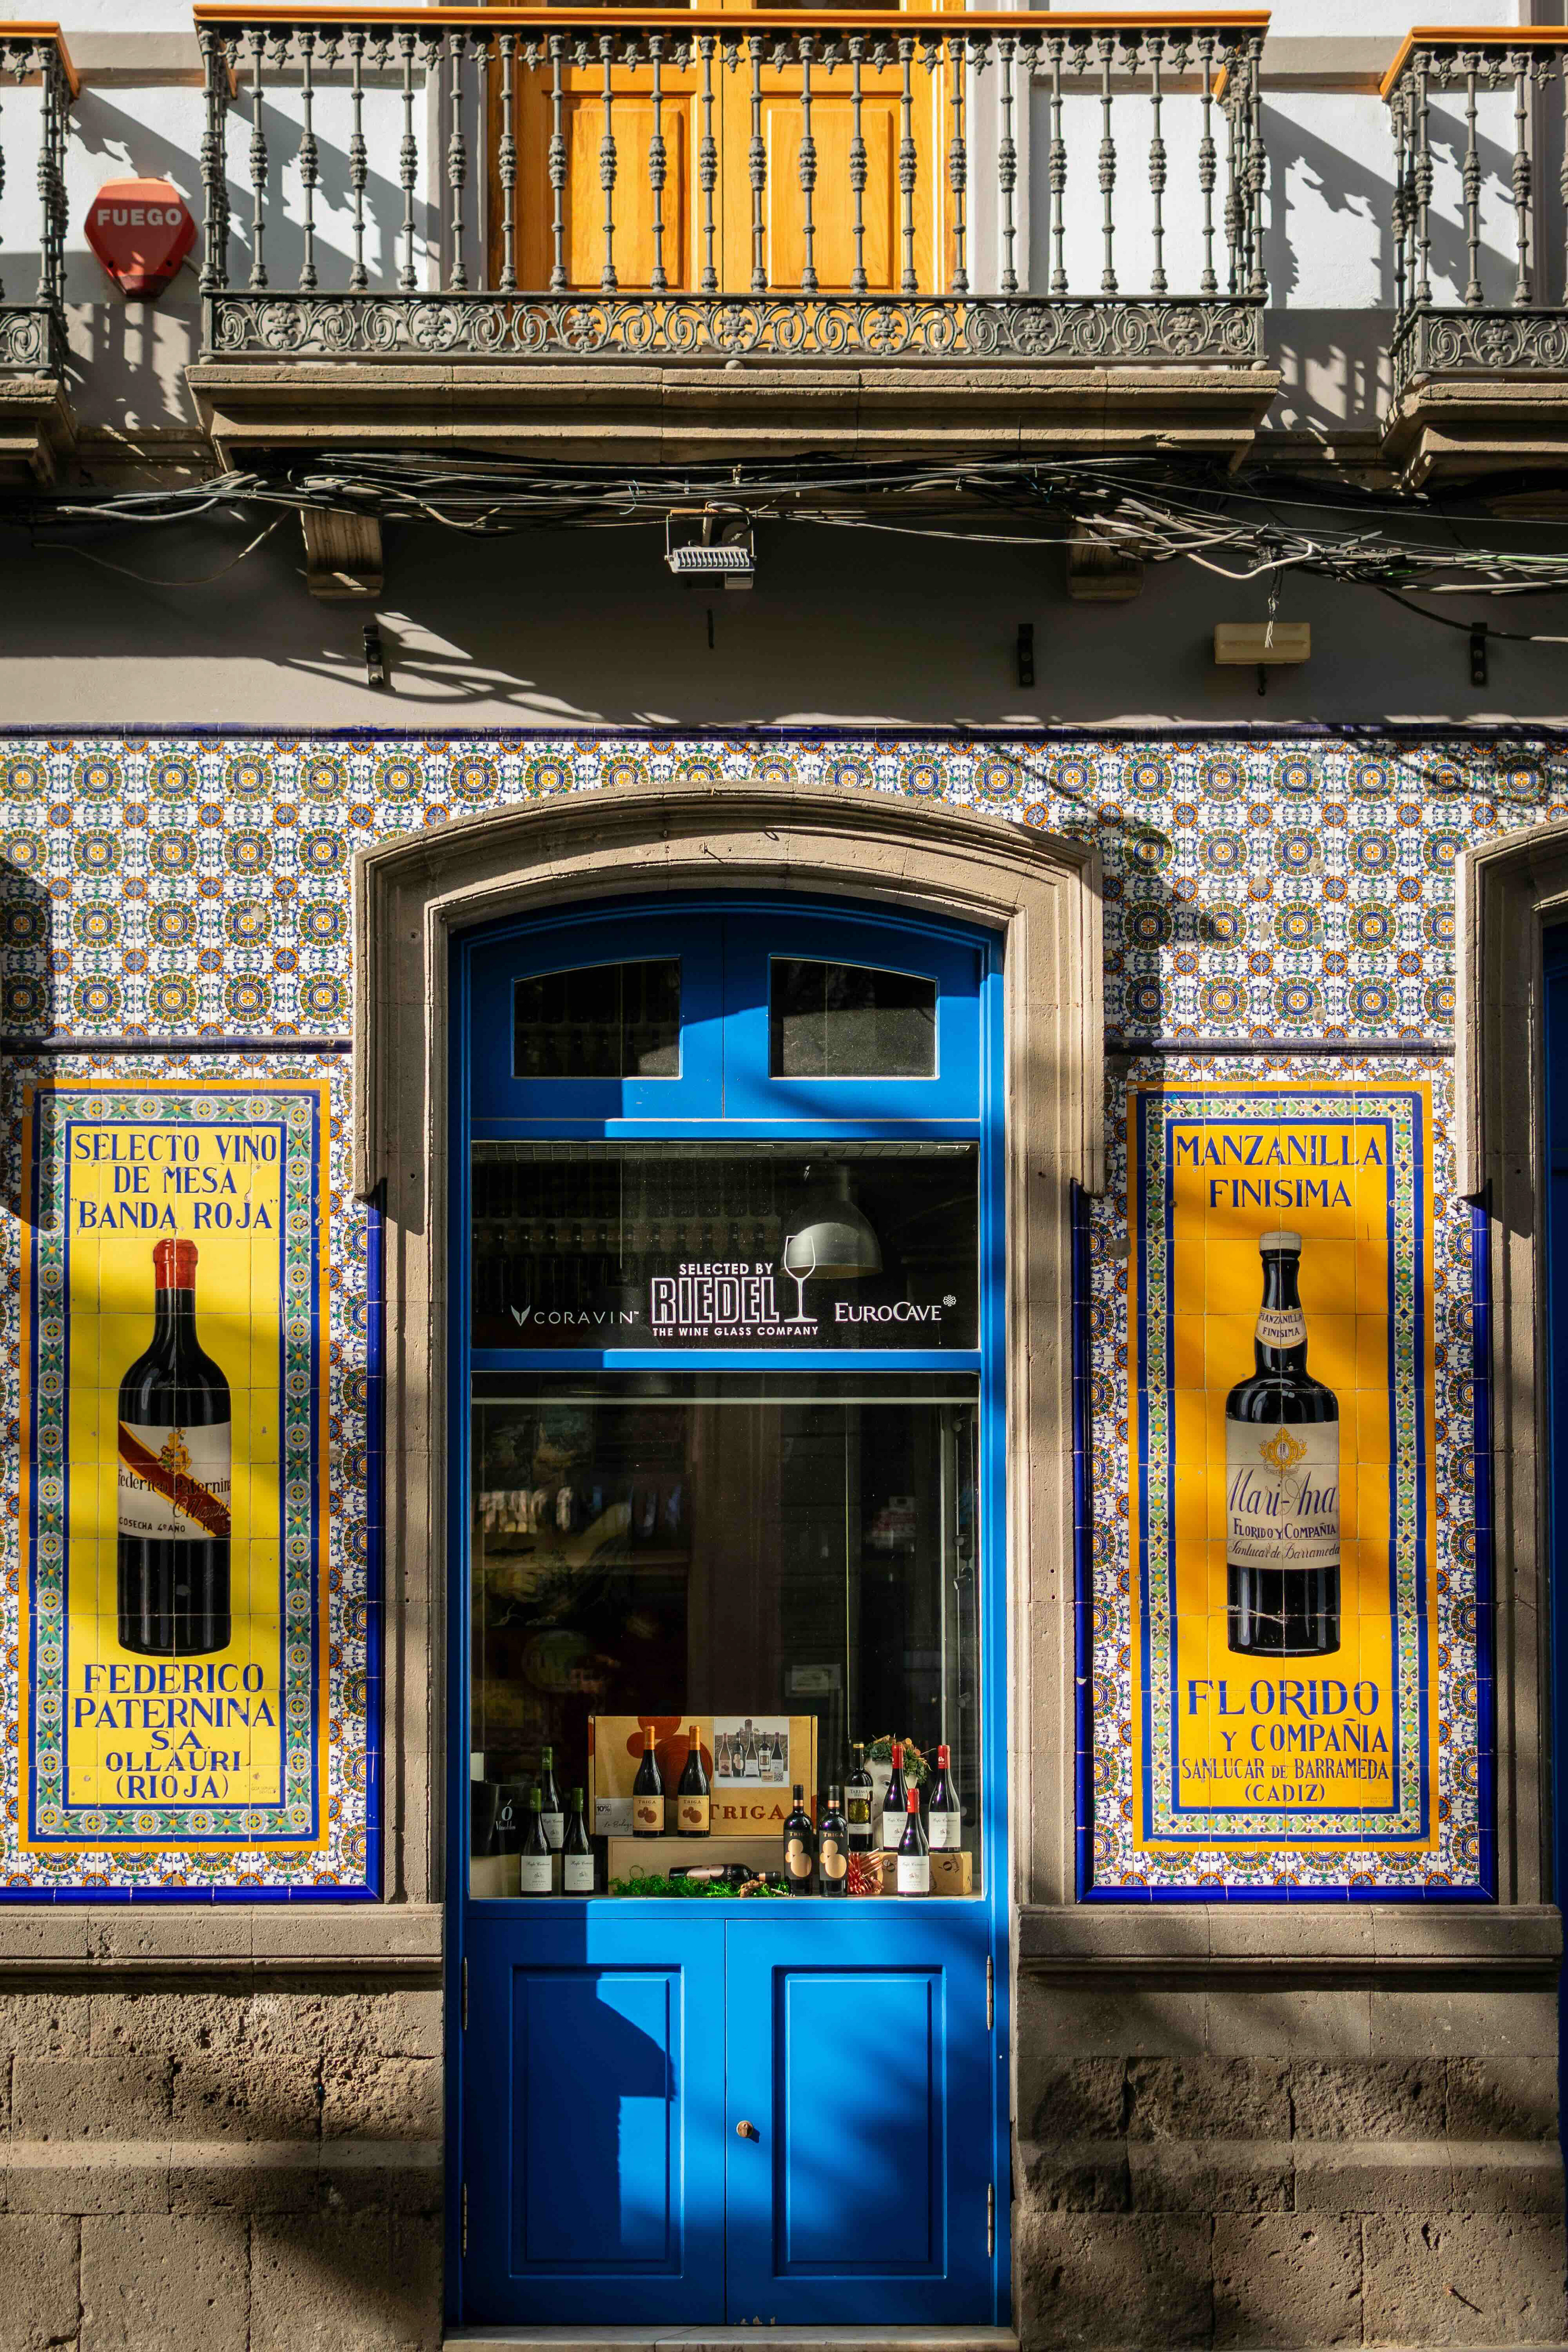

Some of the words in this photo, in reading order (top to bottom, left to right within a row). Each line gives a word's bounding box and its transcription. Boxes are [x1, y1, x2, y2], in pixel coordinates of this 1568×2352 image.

[98, 208, 182, 226] FUEGO
[75, 1134, 199, 1161] SELECTO
[215, 1135, 277, 1162] VINO
[1177, 1135, 1383, 1166] MANZANILLA
[114, 1167, 150, 1193] DE
[163, 1167, 238, 1194] MESA
[1209, 1179, 1352, 1207] FINISIMA
[679, 1263, 749, 1275] SELECTED
[756, 1263, 773, 1274] BY
[652, 1276, 780, 1324] RIEDEL
[653, 1327, 673, 1336] THE
[679, 1327, 708, 1336] WINE
[714, 1327, 751, 1336] GLASS
[757, 1326, 818, 1336] COMPANY
[119, 1517, 152, 1531] COSECHA
[168, 1522, 185, 1532] AÑO
[1271, 1546, 1281, 1558] de
[83, 1663, 264, 1694] FEDERICO
[1187, 1679, 1379, 1720] FLORIDO
[74, 1697, 277, 1728] PATERNINA
[151, 1729, 211, 1751] S.A.
[1220, 1731, 1237, 1752] Y
[1251, 1718, 1389, 1753] COMPAÑIA
[106, 1751, 242, 1772] OLLAURI
[1182, 1758, 1265, 1779] SANLUCAR
[1272, 1765, 1288, 1779] DE
[1294, 1758, 1390, 1780] BARRAMEDA
[117, 1774, 229, 1800] (RIOJA)
[1245, 1784, 1325, 1802] (CADIZ)
[710, 1804, 787, 1820] TRIGA
